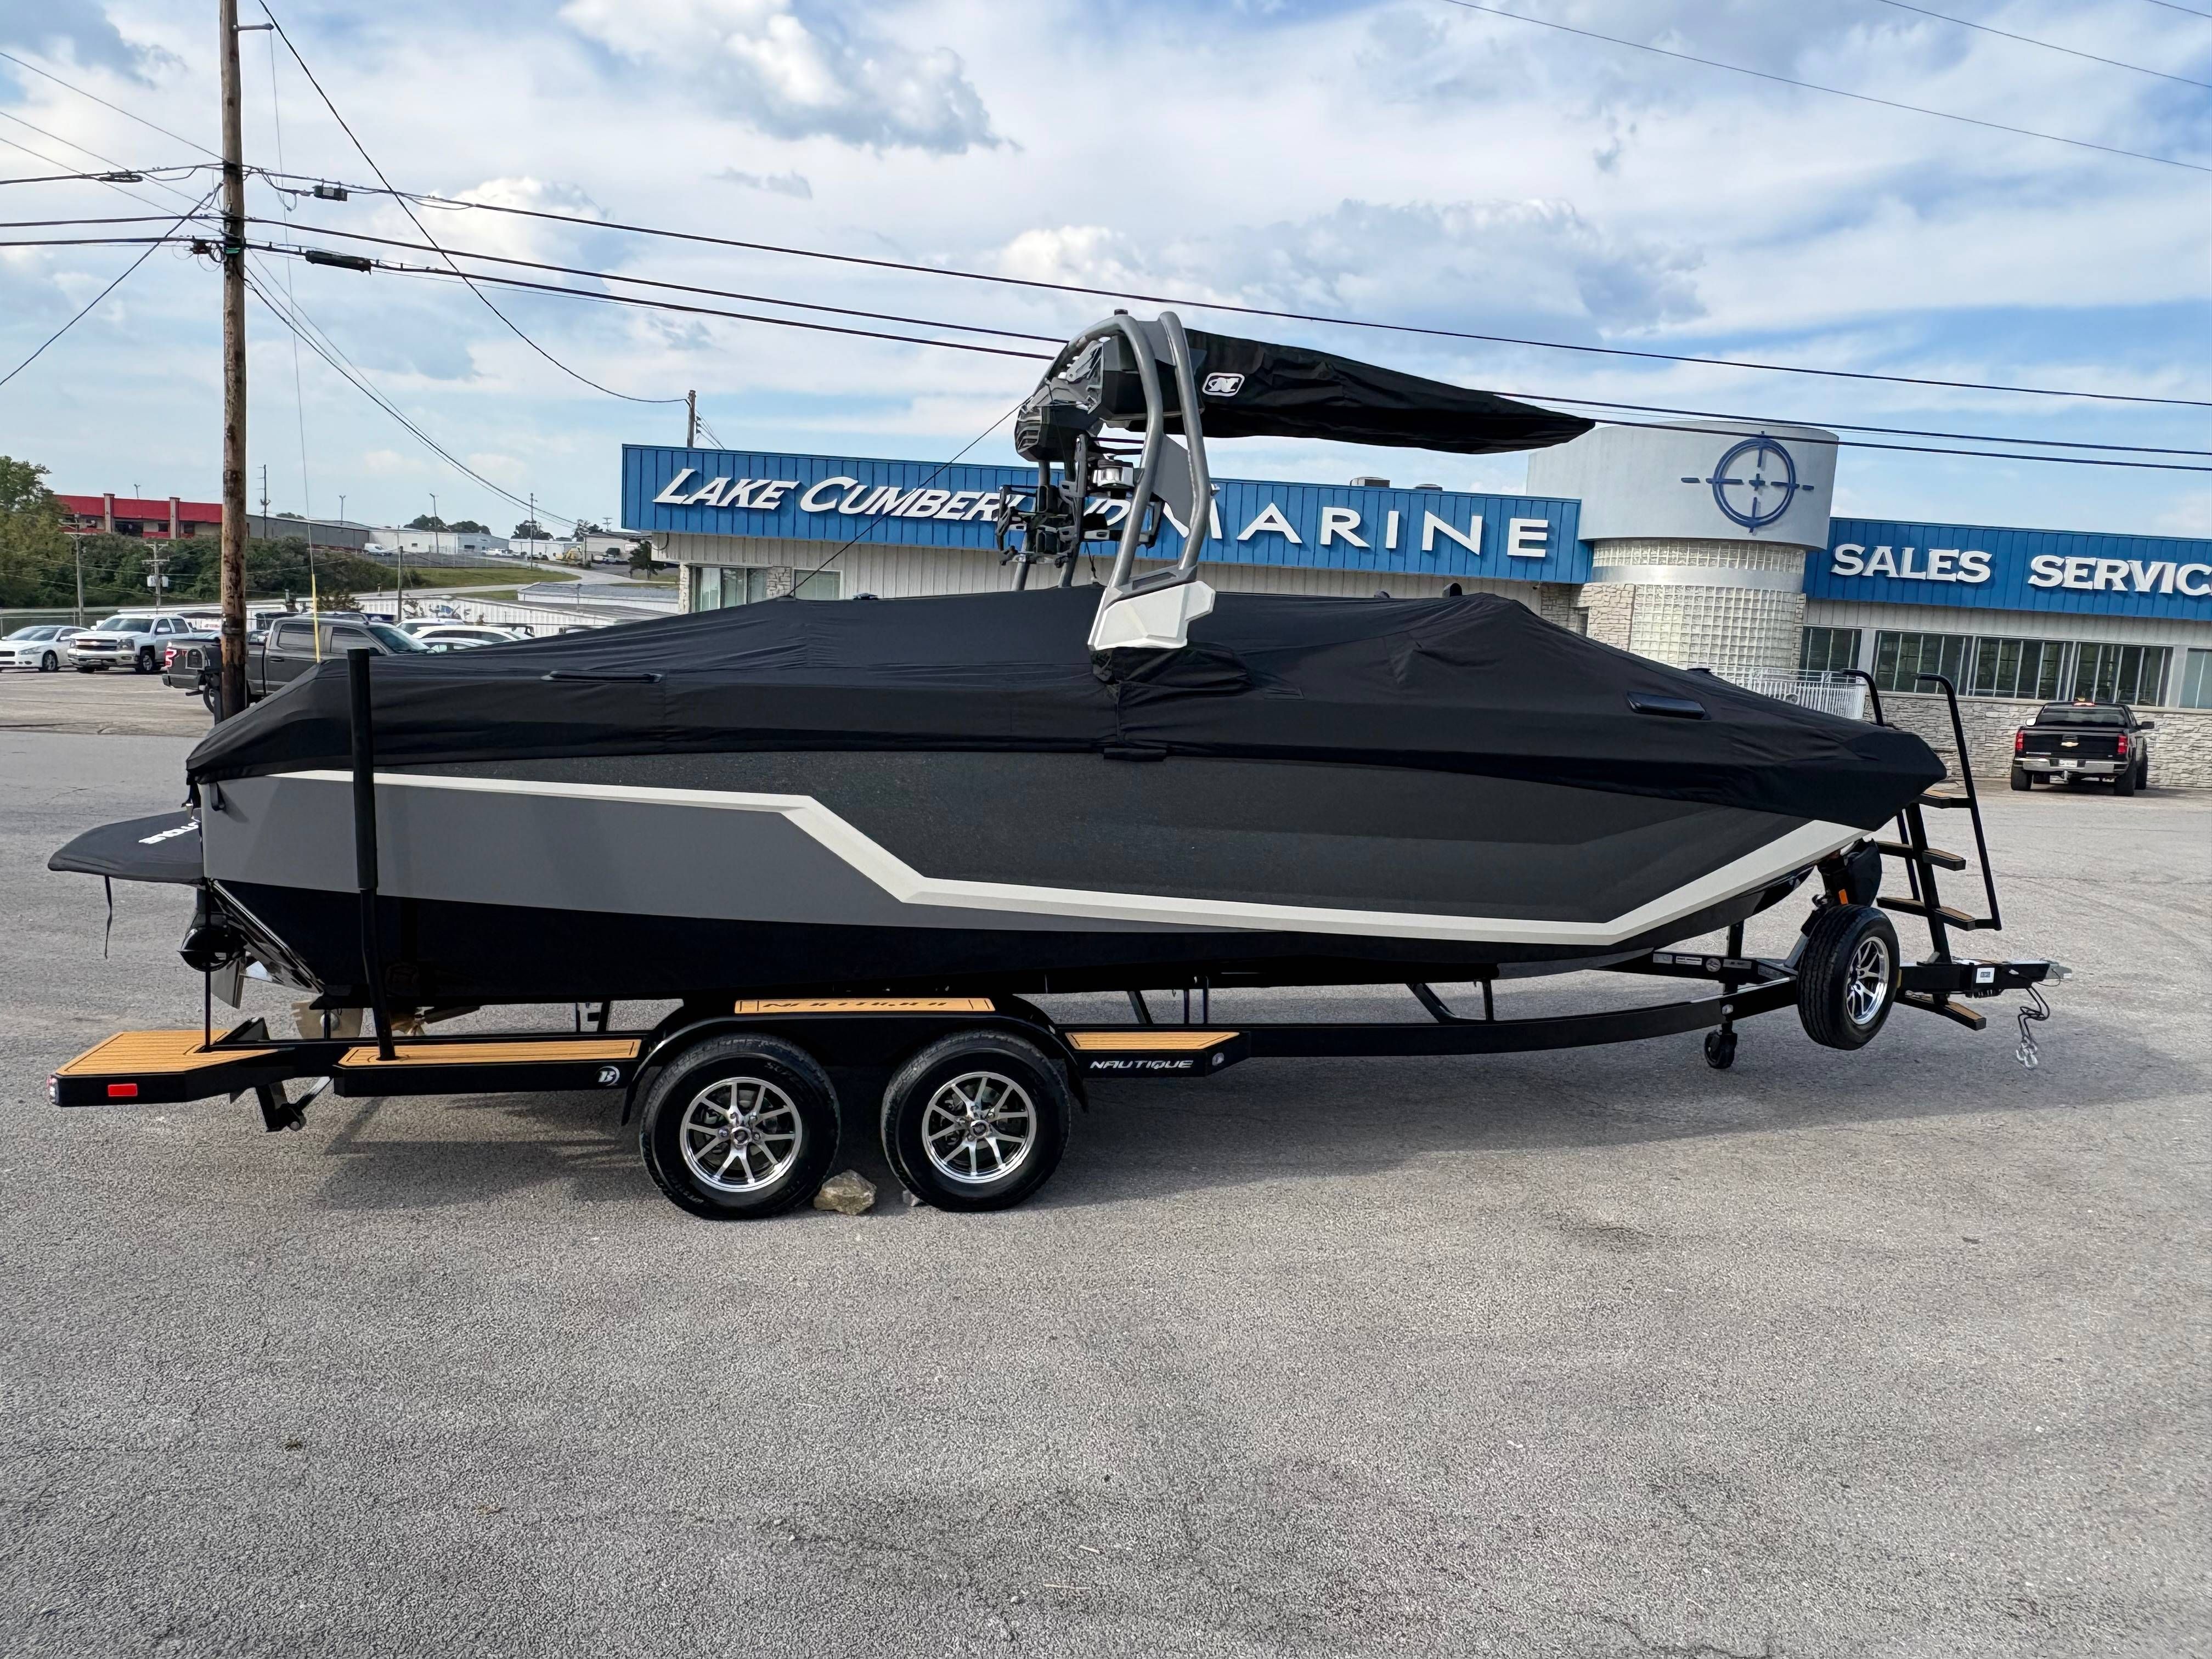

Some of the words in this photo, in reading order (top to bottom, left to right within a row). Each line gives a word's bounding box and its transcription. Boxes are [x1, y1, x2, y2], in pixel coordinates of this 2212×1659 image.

[653, 468, 799, 511] LAKE
[800, 476, 1131, 526] CUMBERD
[1831, 544, 1992, 583] SALES
[2028, 555, 2212, 596] SERVIC
[1090, 1060, 1194, 1069] NAUTIQUE
